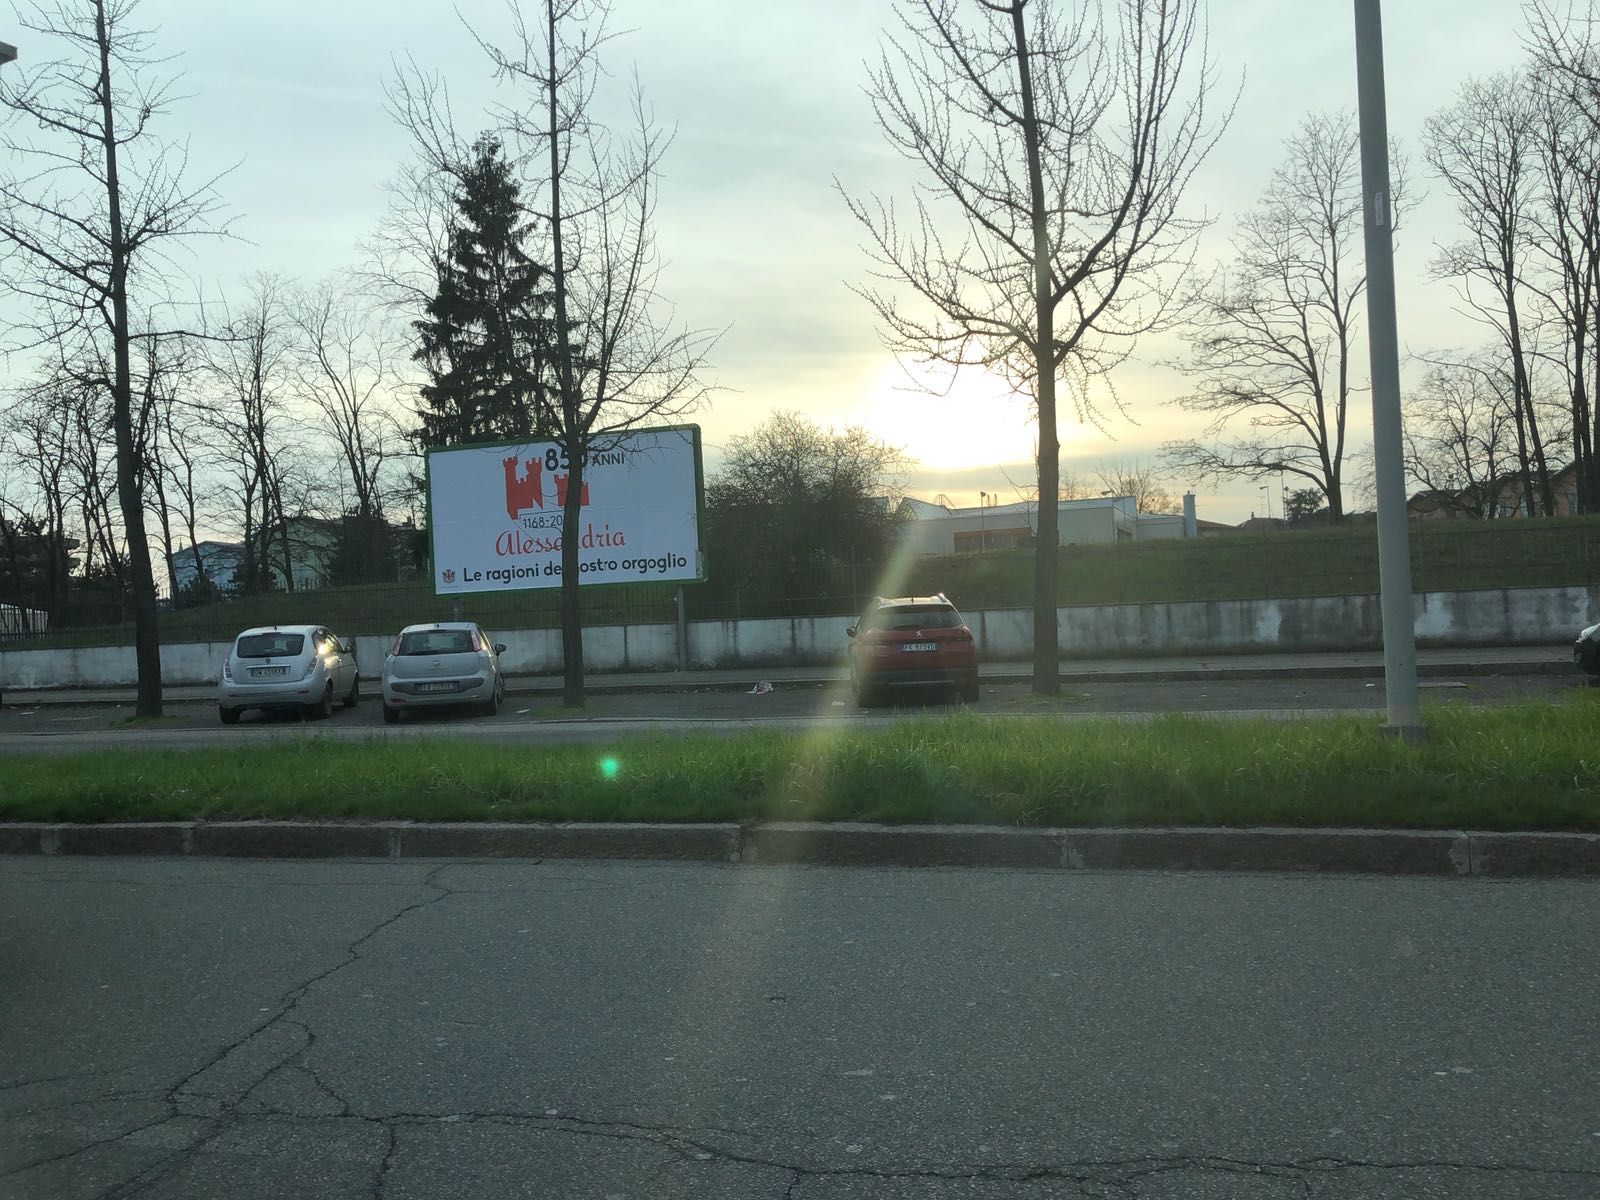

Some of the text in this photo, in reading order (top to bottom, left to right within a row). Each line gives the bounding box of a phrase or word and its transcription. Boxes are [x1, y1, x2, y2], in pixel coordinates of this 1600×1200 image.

[592, 452, 625, 467] ANNI
[495, 523, 626, 556] Alessadria
[463, 552, 687, 584] Le ragioni de ostro orgoglio
